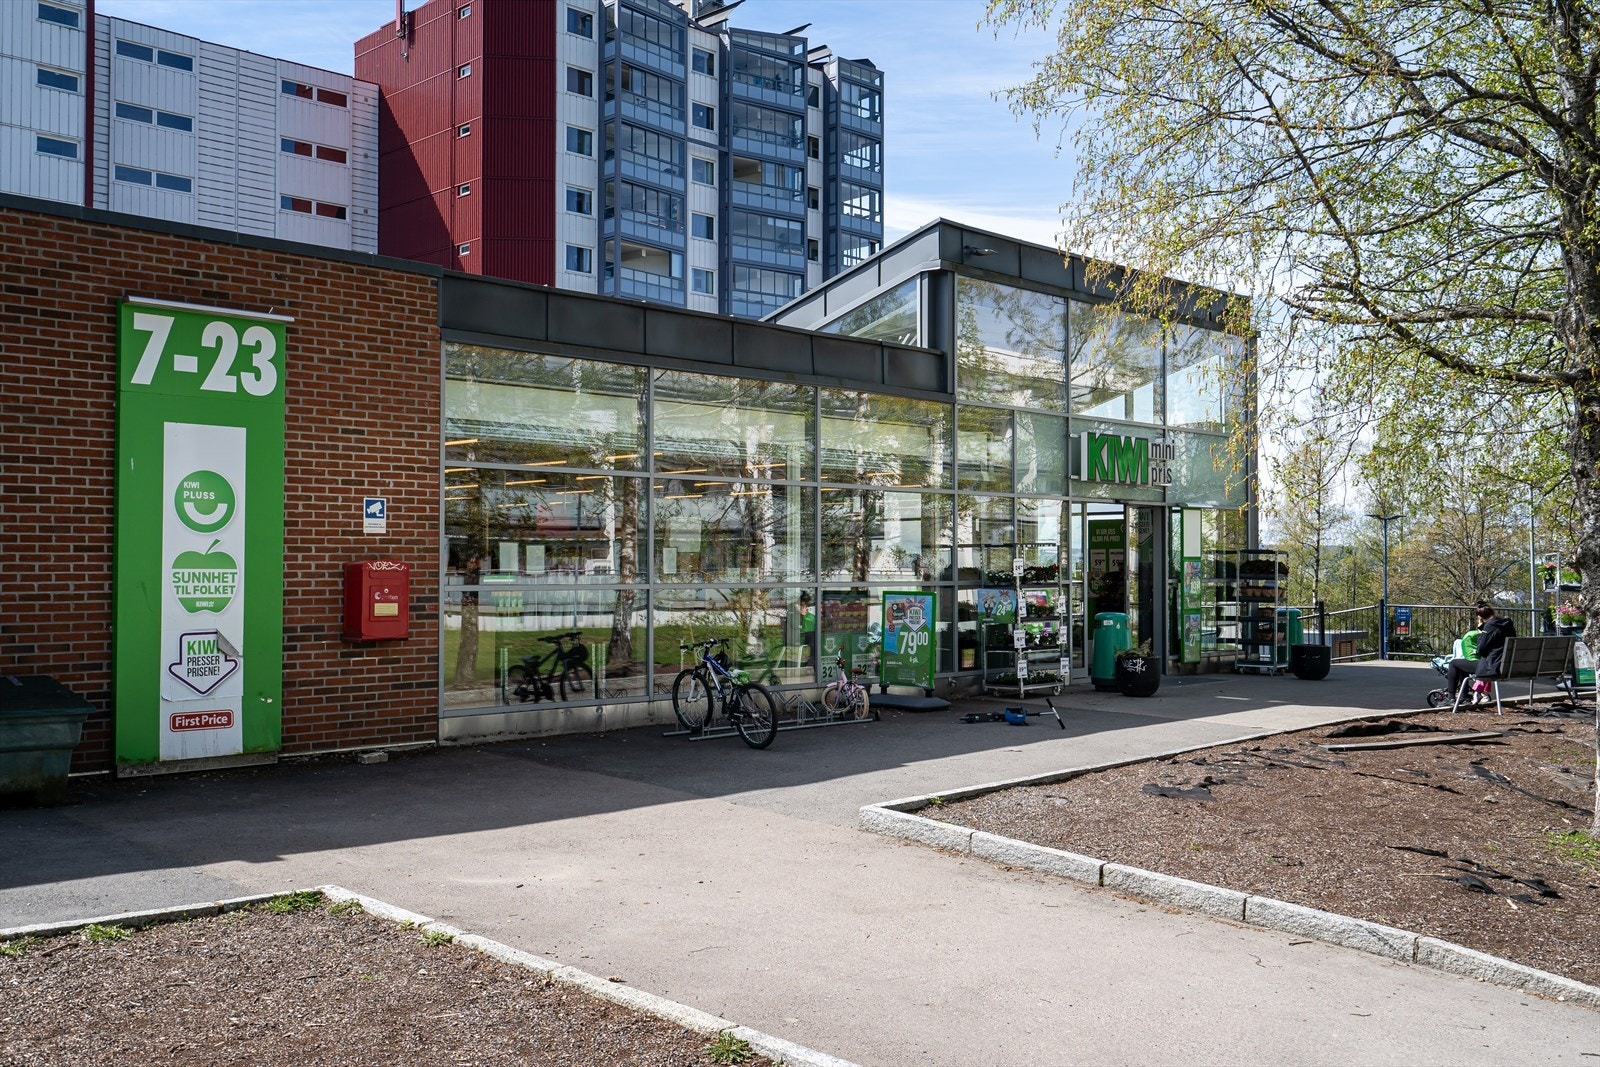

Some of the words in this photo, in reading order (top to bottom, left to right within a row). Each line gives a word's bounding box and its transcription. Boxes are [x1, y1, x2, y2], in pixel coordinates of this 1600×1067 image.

[131, 312, 278, 396] 7-23
[1151, 440, 1175, 460] mini
[1087, 432, 1149, 484] KIWI
[1151, 461, 1172, 486] pris
[183, 481, 200, 489] KIWI
[183, 491, 215, 500] PLUSS
[172, 571, 238, 584] SUNNHET
[174, 585, 191, 595] TIL
[193, 585, 236, 595] FOLKET
[187, 655, 220, 667] PRESSER
[187, 666, 220, 678] PRISENE!
[175, 716, 200, 727] First
[201, 714, 228, 725] Price
